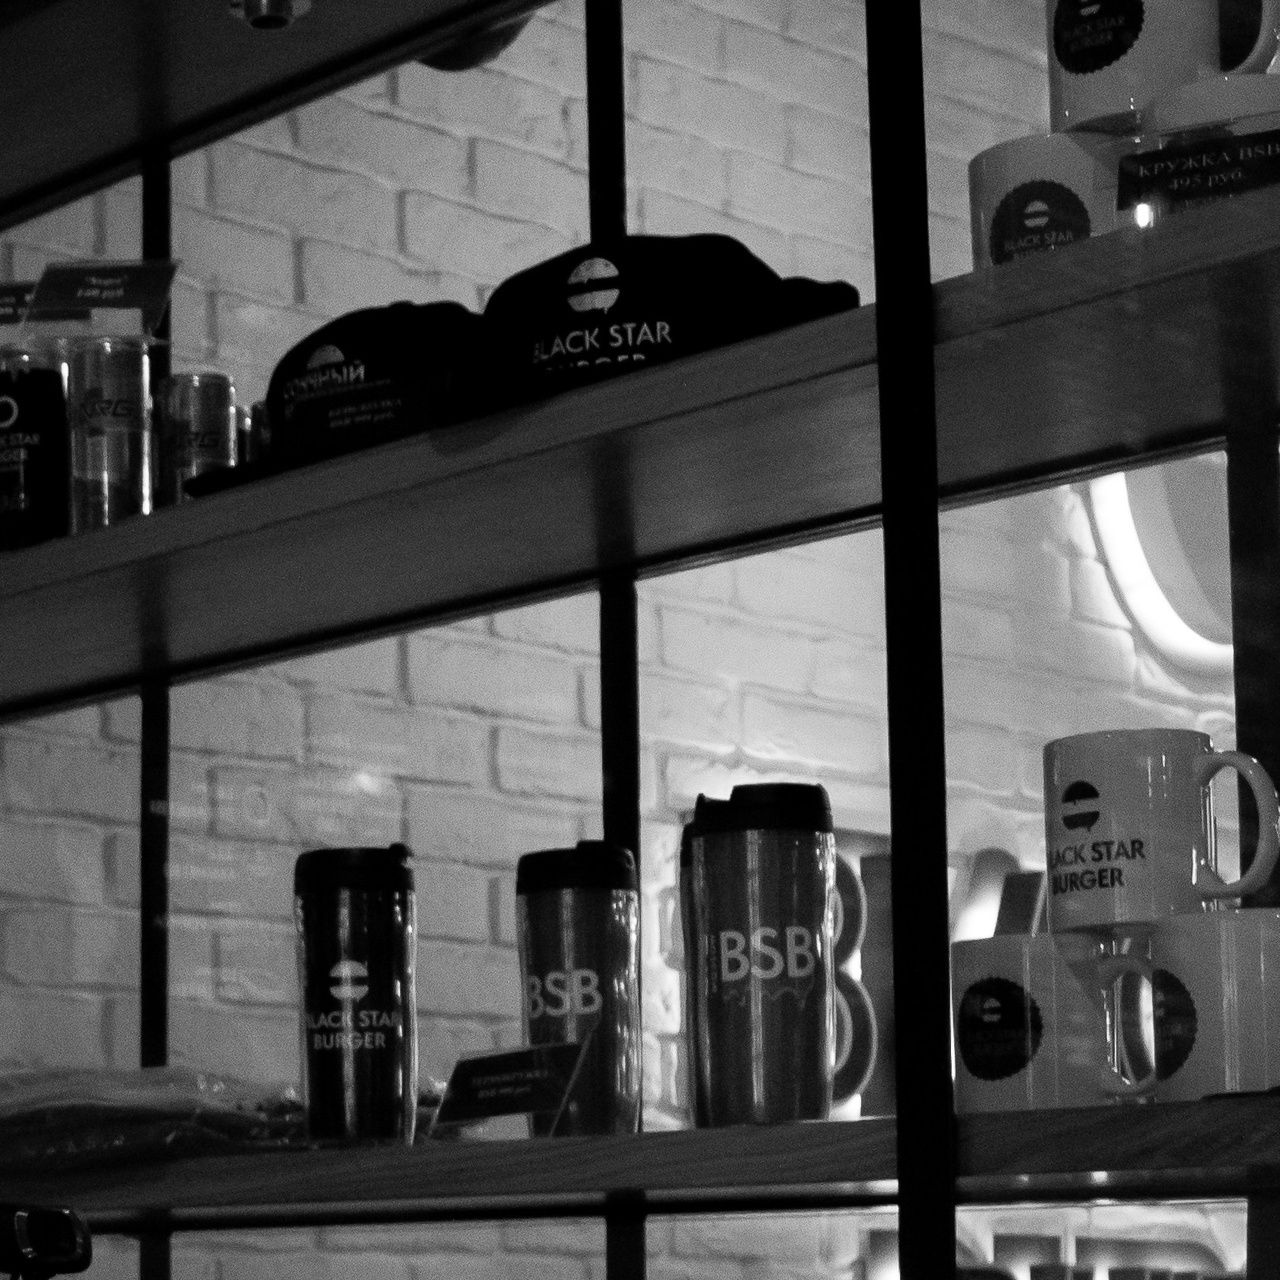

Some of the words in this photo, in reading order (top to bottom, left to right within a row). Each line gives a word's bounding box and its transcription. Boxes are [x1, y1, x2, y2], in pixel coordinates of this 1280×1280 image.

[1140, 152, 1230, 177] КРУЖКА
[610, 321, 672, 347] STAR
[1091, 838, 1145, 862] STAR
[720, 925, 816, 982] BSB
